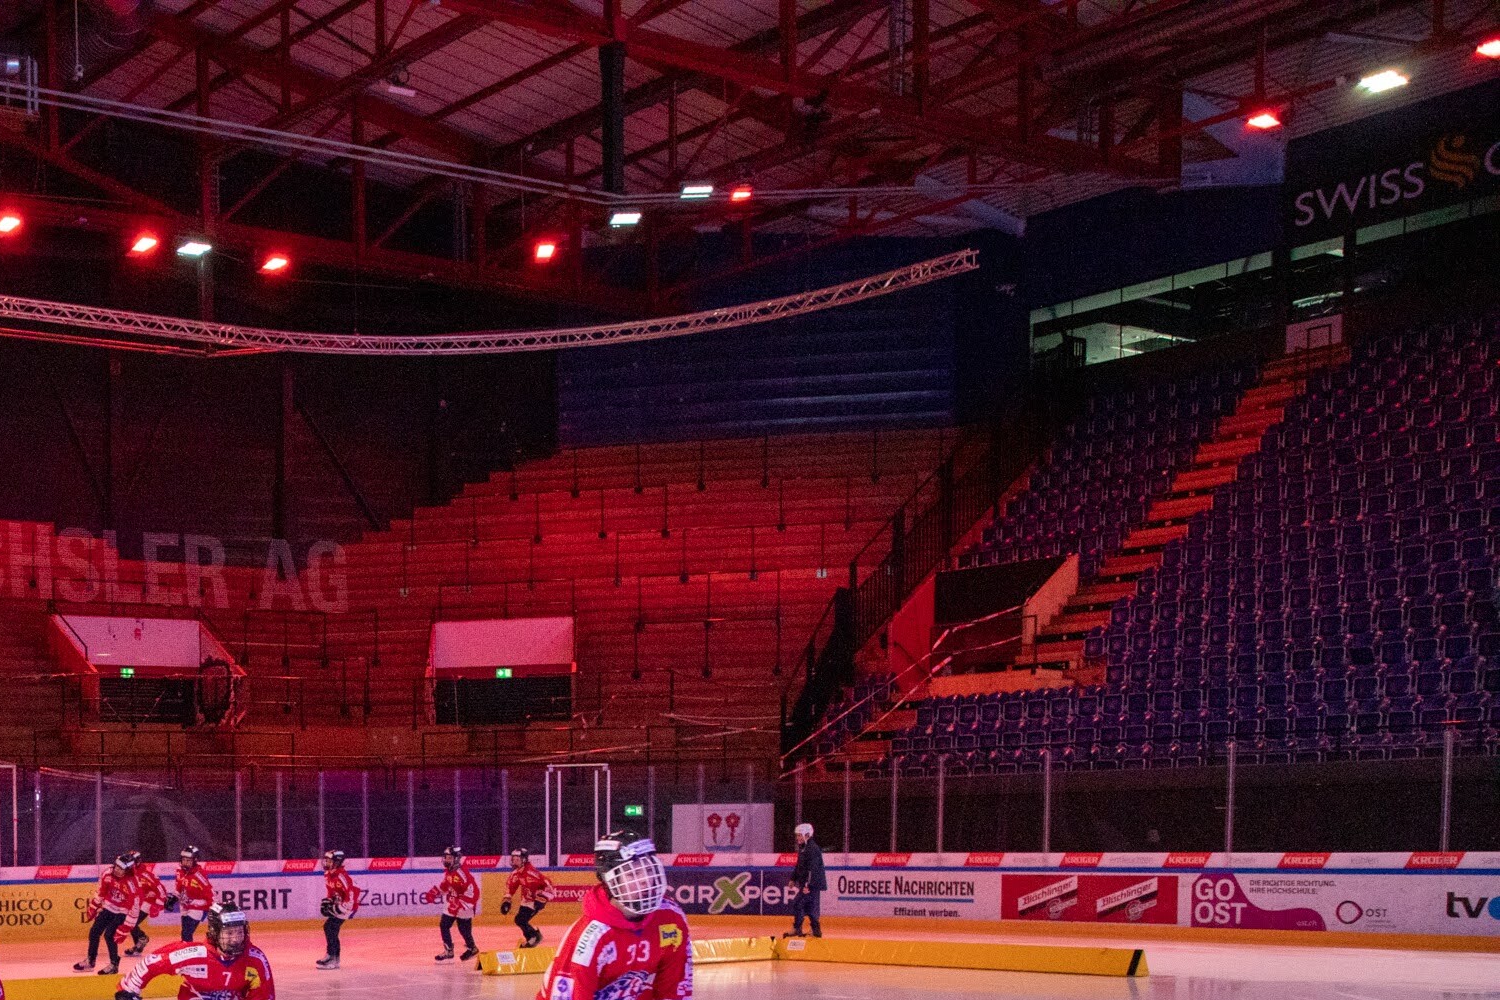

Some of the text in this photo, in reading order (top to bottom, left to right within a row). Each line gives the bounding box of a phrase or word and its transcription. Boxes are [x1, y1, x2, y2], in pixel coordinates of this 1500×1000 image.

[1294, 162, 1425, 227] SWISS
[259, 538, 350, 613] AG
[837, 875, 975, 896] OBERSEE NACHRICHTEN
[1194, 878, 1236, 900] GO
[1262, 879, 1296, 887] RICHTIGE
[1296, 880, 1337, 888] RICHTUNG.
[1266, 887, 1318, 896] HOCHSCHULE.
[215, 888, 292, 911] BERIT
[358, 888, 445, 907] Zauntea
[893, 906, 961, 918] Effizient werben.
[1194, 901, 1248, 925] OST
[1365, 908, 1388, 918] OST
[222, 971, 232, 987] 7
